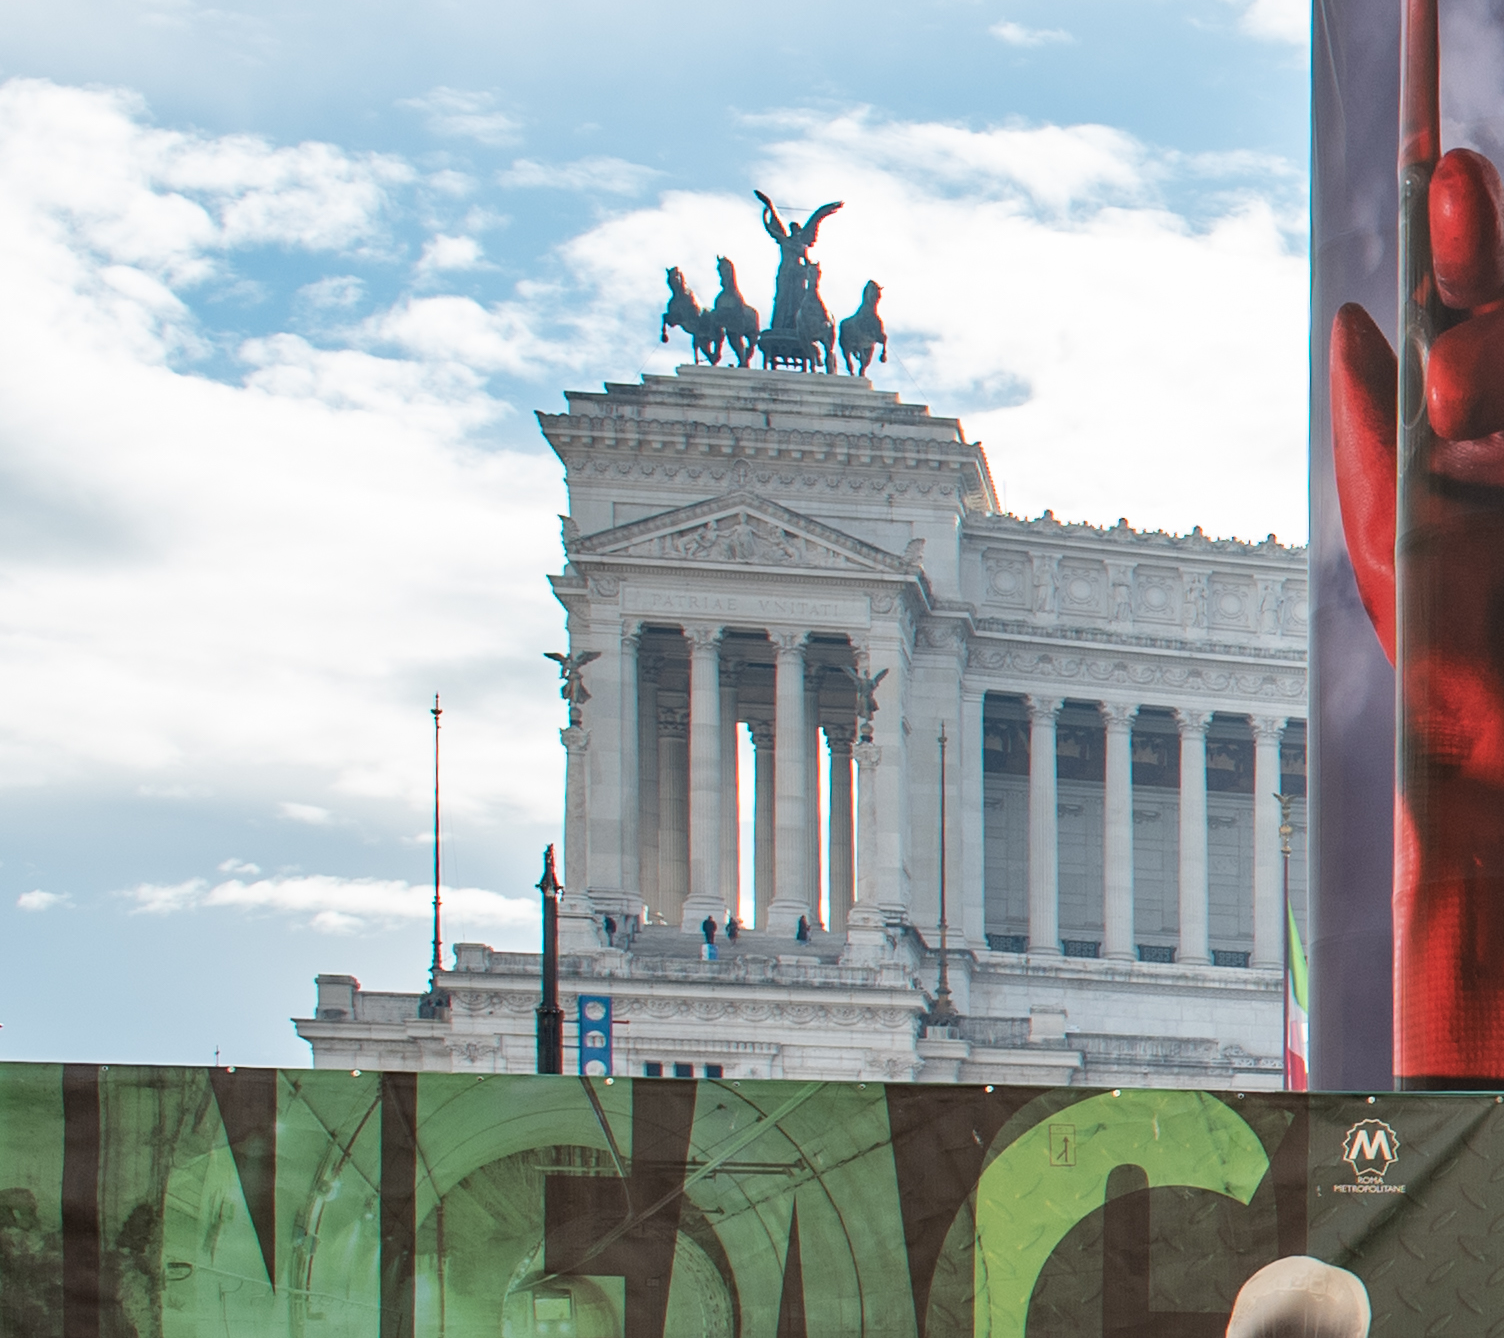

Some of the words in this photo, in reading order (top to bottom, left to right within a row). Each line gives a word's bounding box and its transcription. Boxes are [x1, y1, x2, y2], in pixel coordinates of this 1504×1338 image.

[652, 593, 738, 611] PATRIAE
[1357, 1176, 1385, 1184] ROMA
[1333, 1184, 1406, 1193] METROPOLITANE
